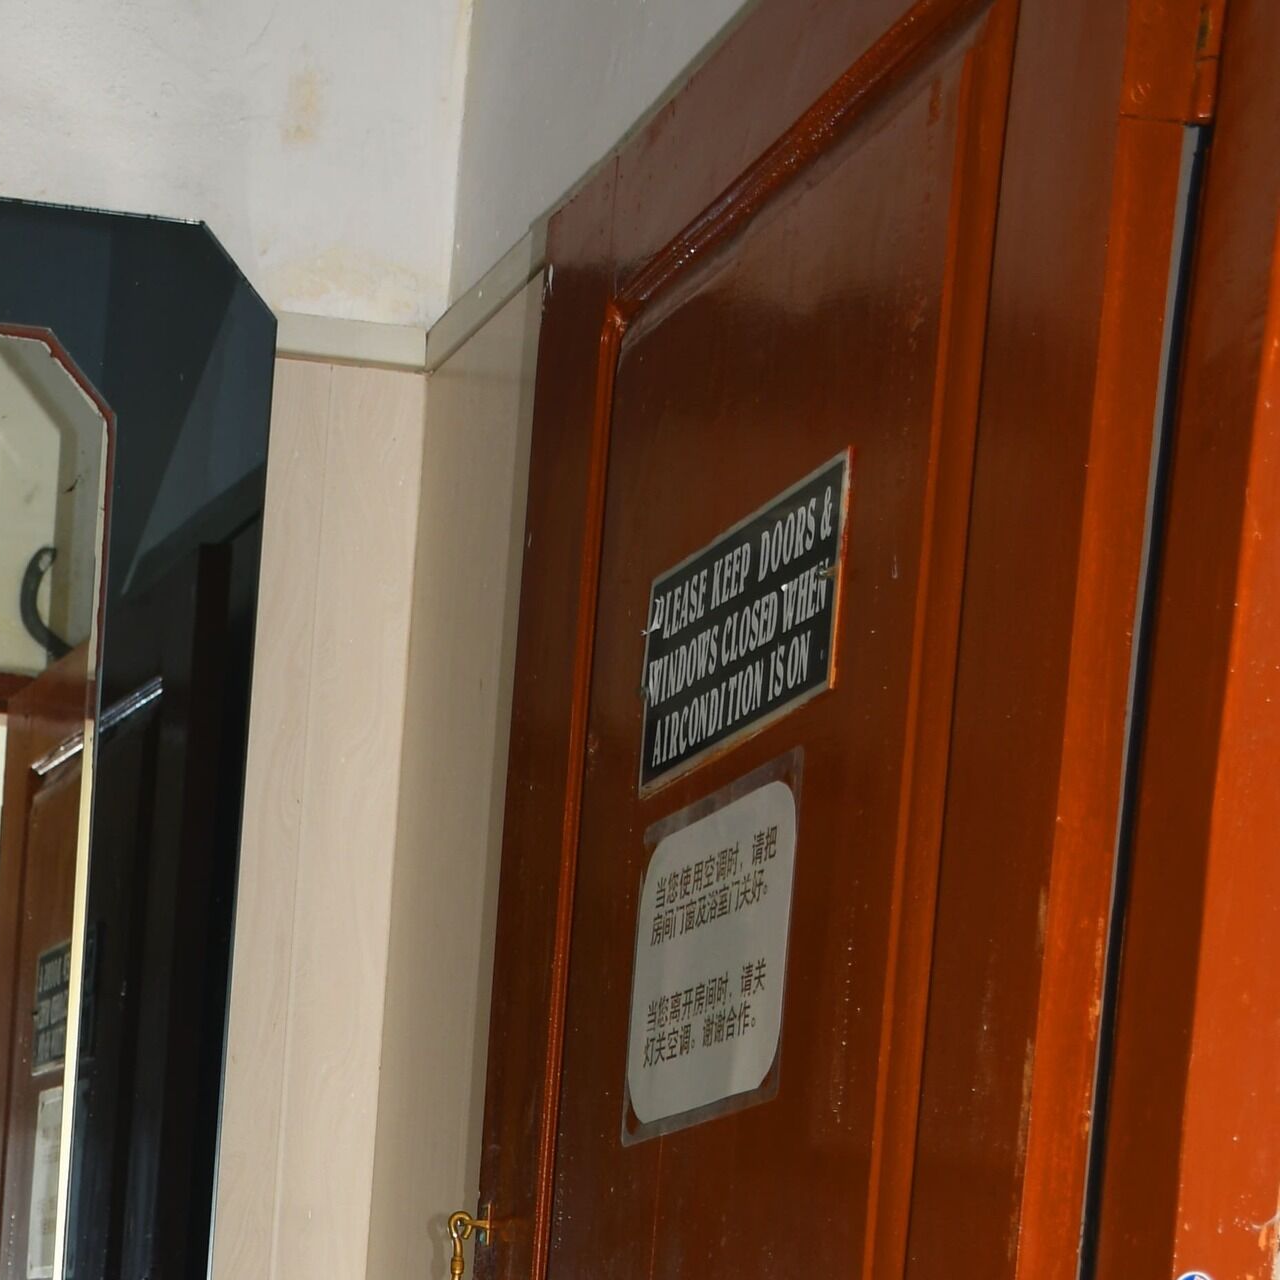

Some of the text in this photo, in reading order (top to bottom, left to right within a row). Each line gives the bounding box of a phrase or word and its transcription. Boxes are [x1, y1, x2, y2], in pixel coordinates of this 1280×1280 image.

[654, 486, 832, 639] PLEASE KEEP DOORS &
[648, 557, 829, 708] WINDOWS CLOSED WHEN
[651, 658, 764, 767] AIRCONDITION
[787, 630, 812, 692] ON
[650, 869, 769, 946] 房间门窗及浴室门关好。
[655, 825, 778, 909] 当您使用空调时，请把
